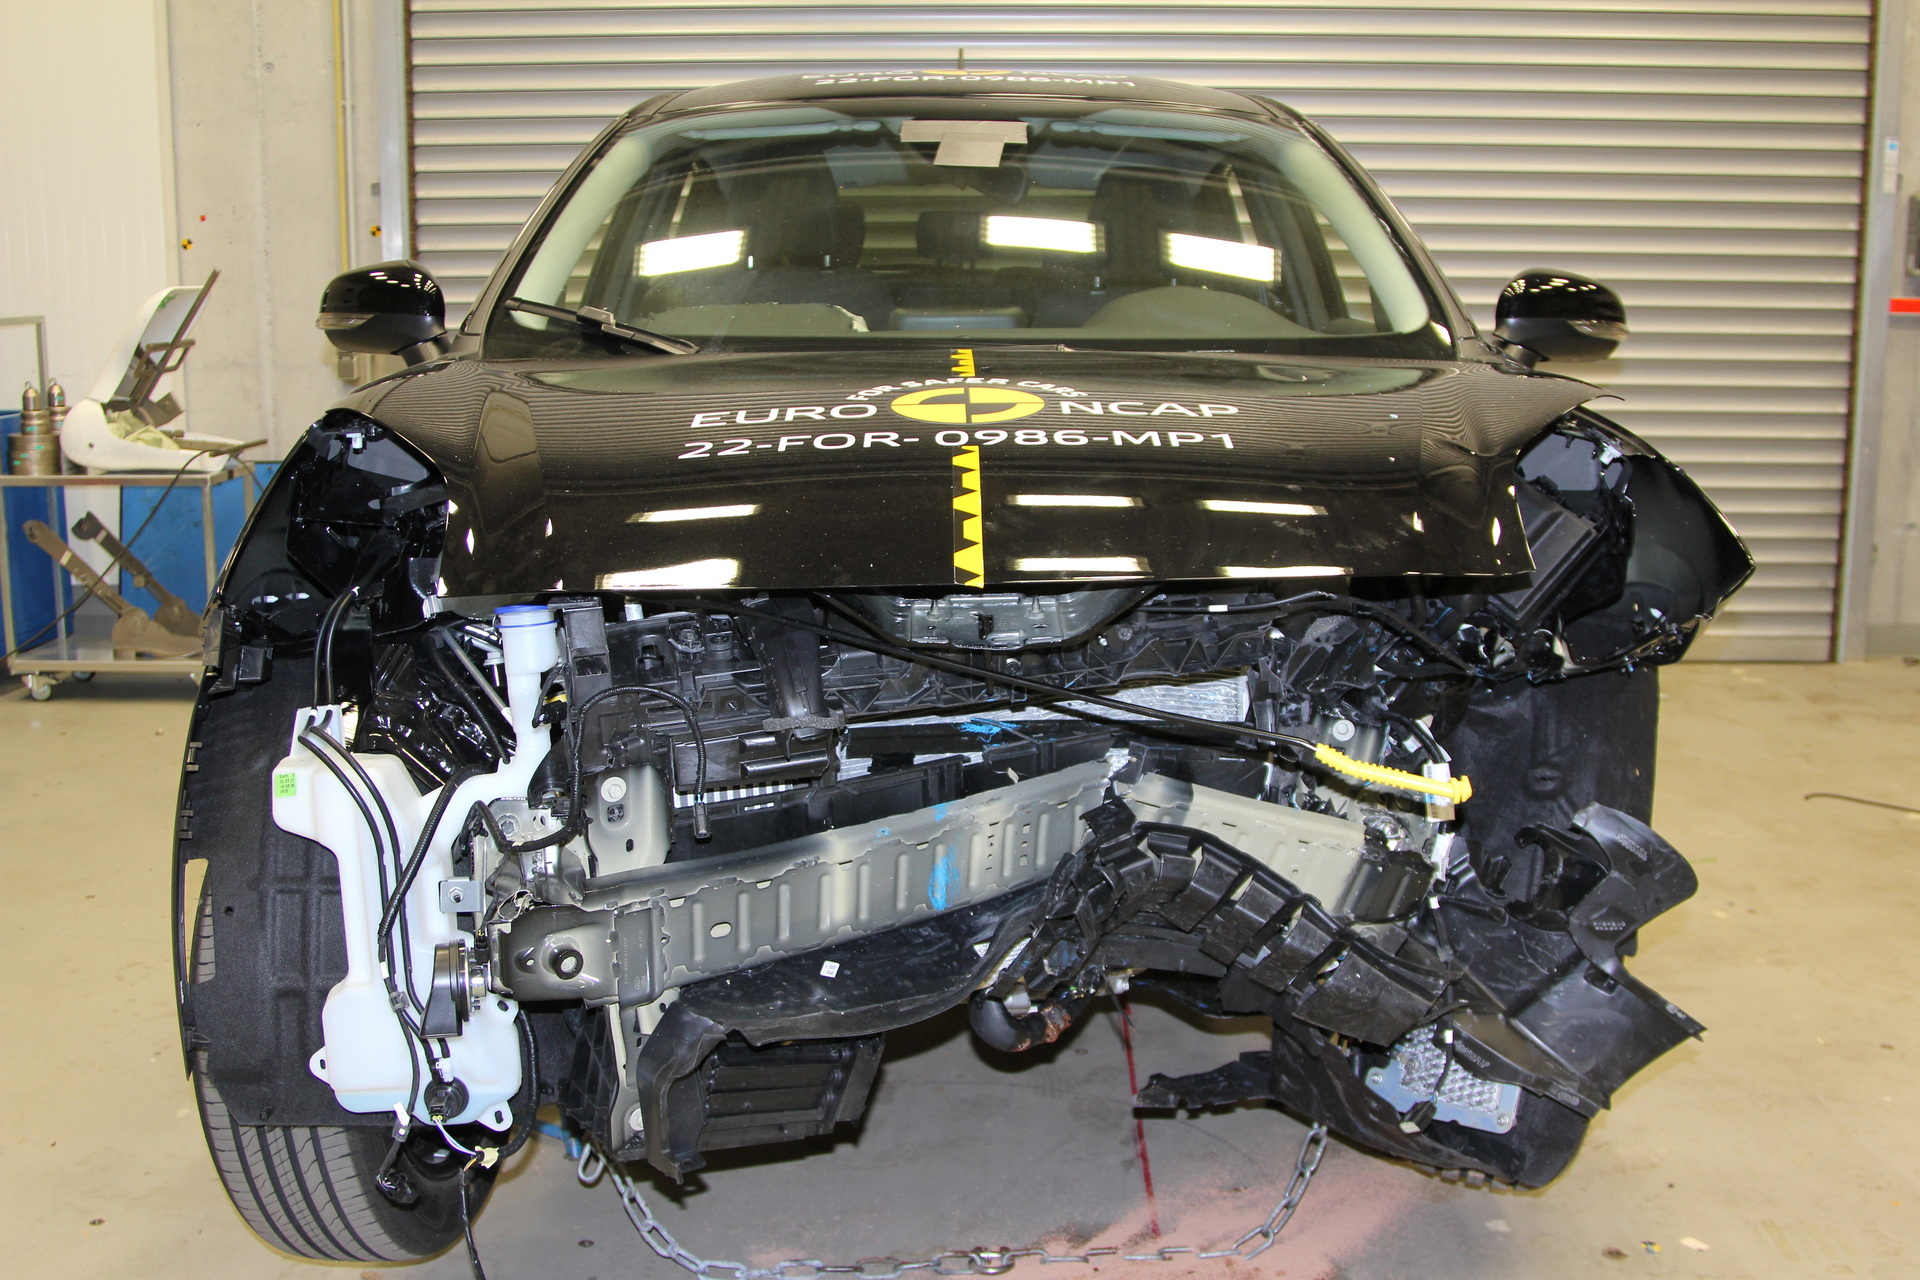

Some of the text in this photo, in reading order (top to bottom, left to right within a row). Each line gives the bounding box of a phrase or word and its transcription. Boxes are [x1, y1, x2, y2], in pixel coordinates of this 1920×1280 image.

[846, 377, 1088, 401] FOR SAFER CARS
[690, 401, 1239, 428] EURO NCAP
